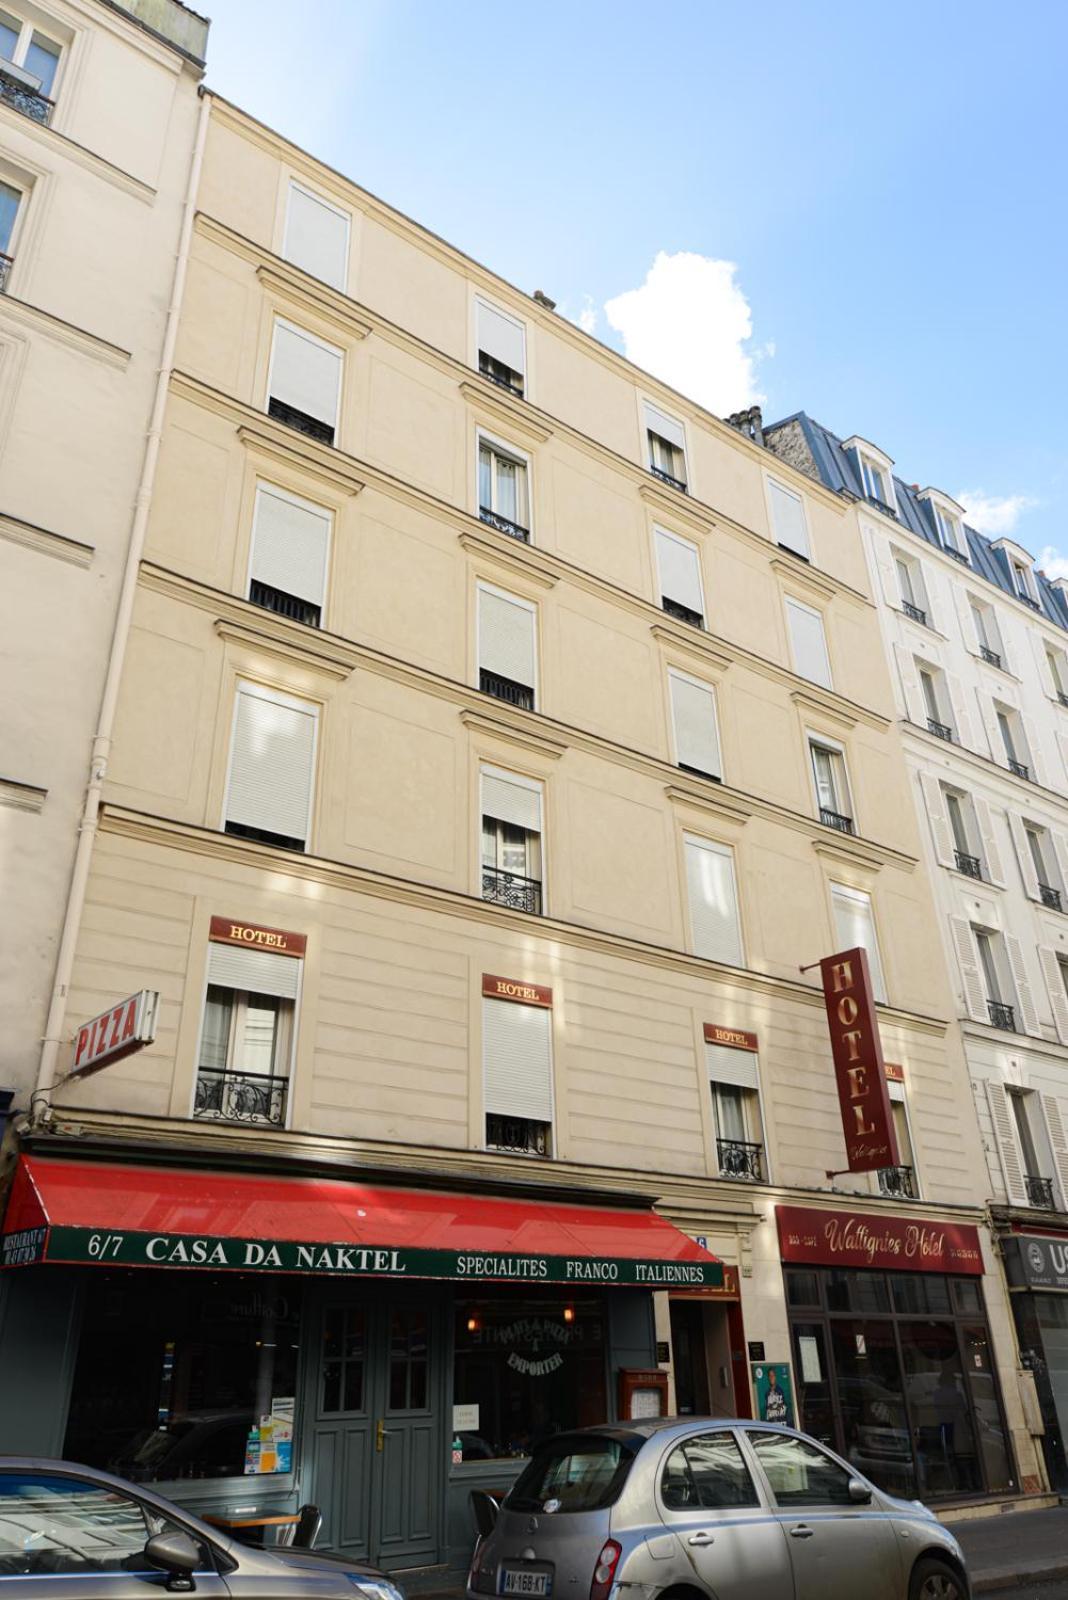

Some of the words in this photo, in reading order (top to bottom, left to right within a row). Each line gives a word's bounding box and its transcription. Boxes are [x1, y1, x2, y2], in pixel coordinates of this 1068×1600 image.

[230, 925, 287, 948] HOTEL
[496, 981, 540, 1001] HOTEL
[75, 999, 137, 1066] PIZZA
[714, 1028, 748, 1046] HOTEL
[832, 961, 876, 1136] HOTEL
[88, 1234, 124, 1260] 6/7
[145, 1237, 228, 1264] CASA
[242, 1242, 283, 1266] DA
[296, 1245, 406, 1272] NAKTEL
[456, 1255, 548, 1278] SPECIALITES
[565, 1261, 619, 1281] FRANCO
[635, 1264, 705, 1284] ITALIENNES
[824, 1218, 902, 1264] Wattignies
[506, 1351, 564, 1377] EMPORTER
